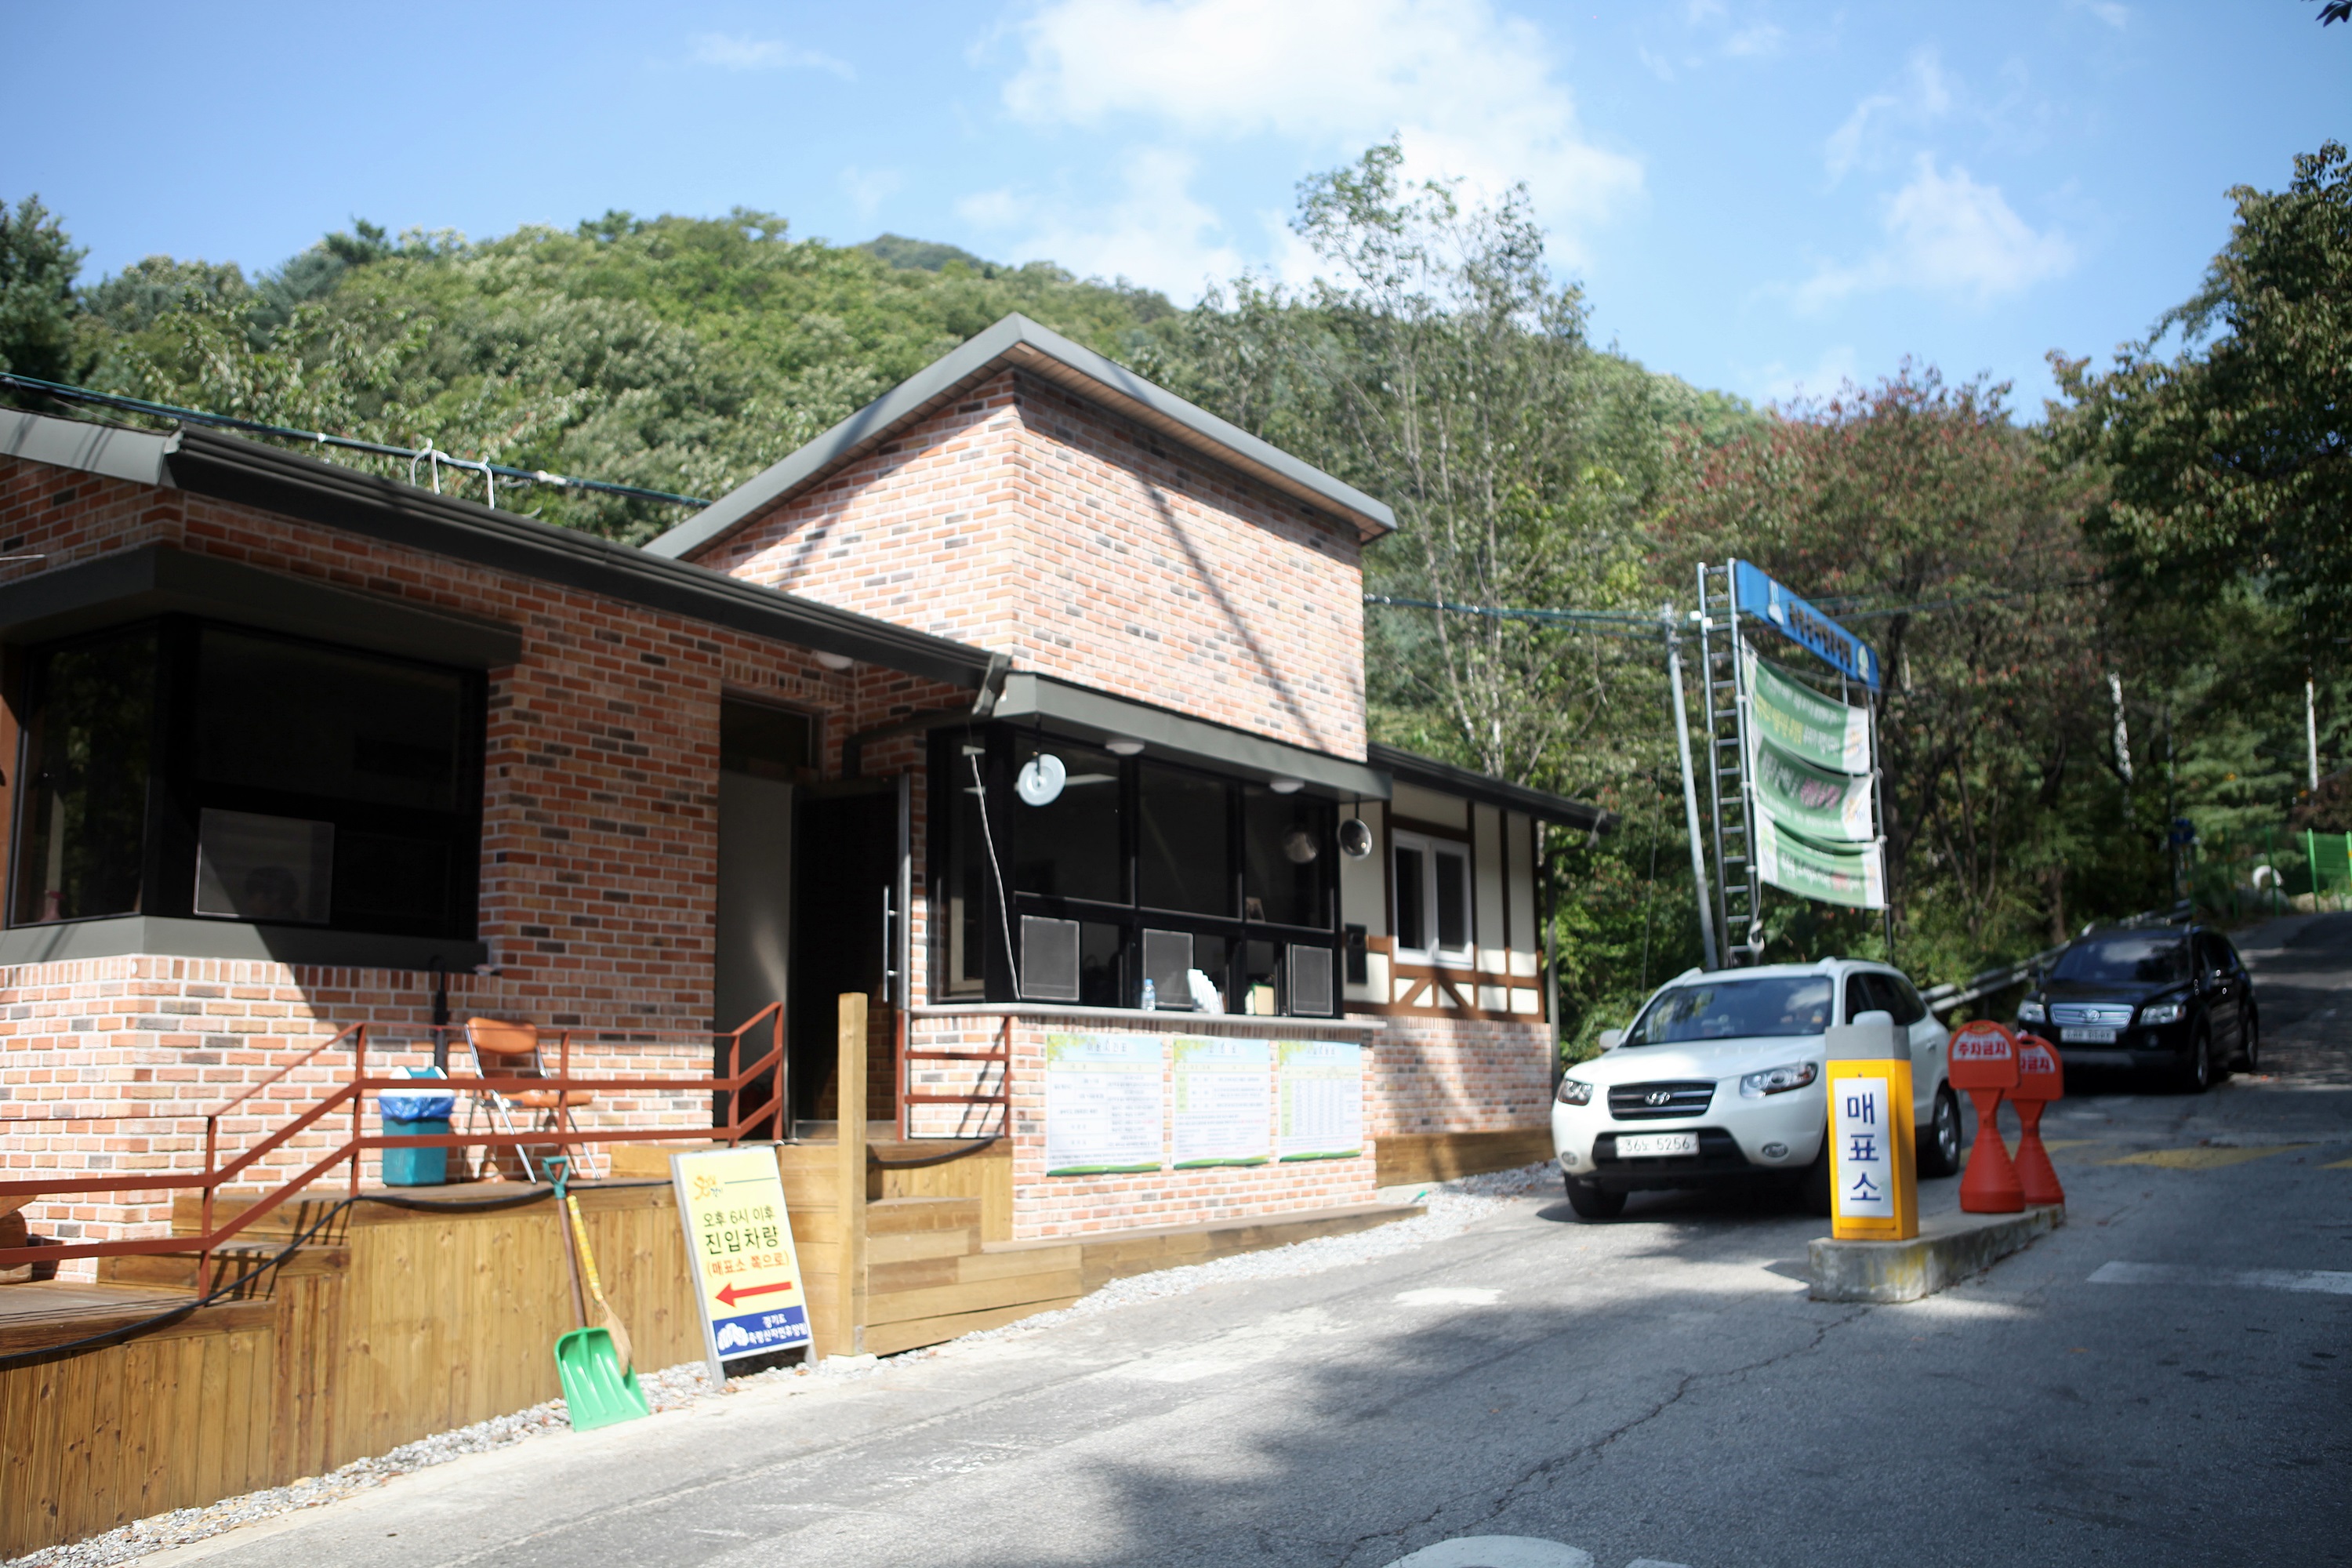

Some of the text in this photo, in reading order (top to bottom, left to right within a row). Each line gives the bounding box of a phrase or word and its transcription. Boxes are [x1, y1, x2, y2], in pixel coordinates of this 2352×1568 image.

[1958, 1040, 2007, 1056] 주차금지
[1657, 1137, 1691, 1150] 5256
[1847, 1092, 1882, 1201] 매표소
[703, 1204, 775, 1228] 오후 6시 이후
[706, 1225, 779, 1255] 진입차량
